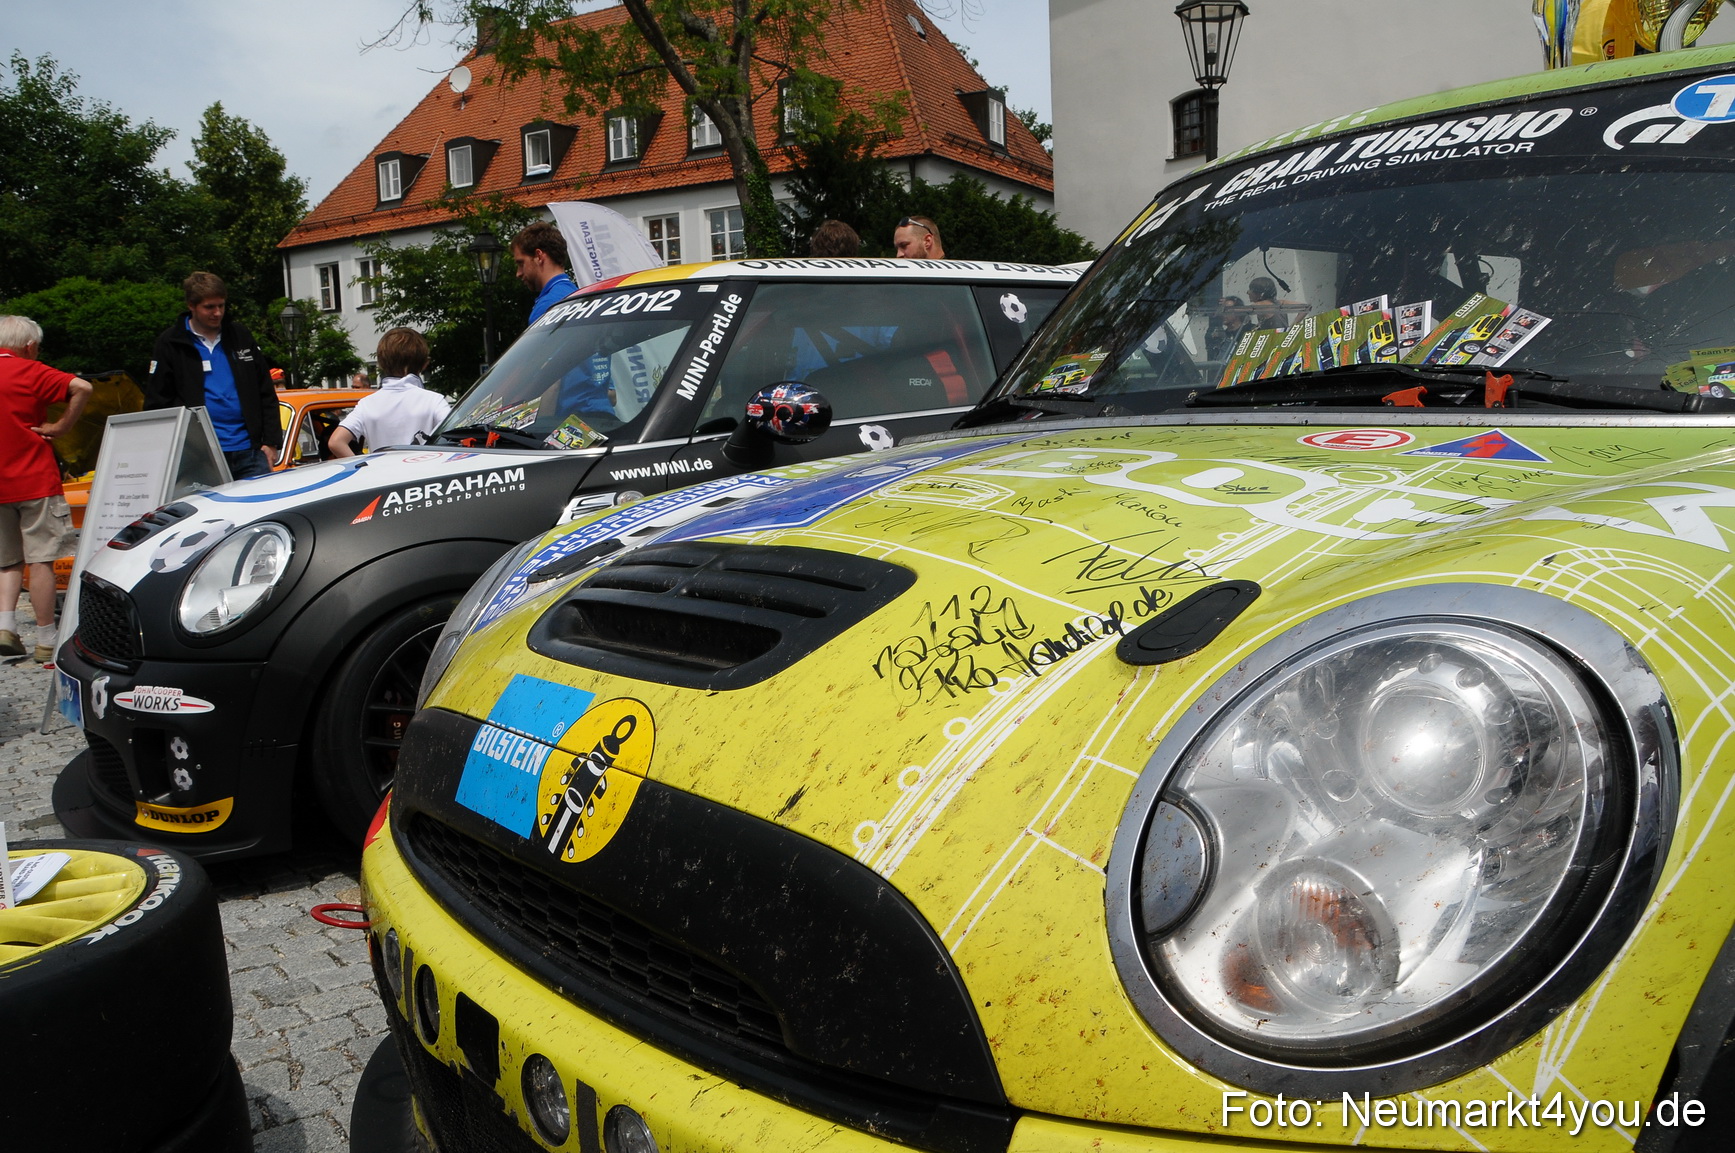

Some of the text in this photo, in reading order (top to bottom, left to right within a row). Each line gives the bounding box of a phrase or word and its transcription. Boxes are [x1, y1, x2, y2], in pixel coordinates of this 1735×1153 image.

[1215, 107, 1574, 199] GRAN TURISMO
[1203, 141, 1535, 213] THE REAL DRIVING SIMULATOR
[600, 289, 682, 317] 2012
[676, 293, 743, 401] MINI-Partl.de
[383, 468, 525, 508] ABRAHAM
[610, 457, 713, 482] www.MINI.de
[382, 483, 526, 517] CNC-Bearbeitung
[132, 694, 181, 711] WORKS
[134, 687, 182, 697] JOHN COOPER
[472, 720, 556, 776] BILSTEIN
[150, 809, 220, 824] DUNLOP
[87, 853, 181, 946] Hankook
